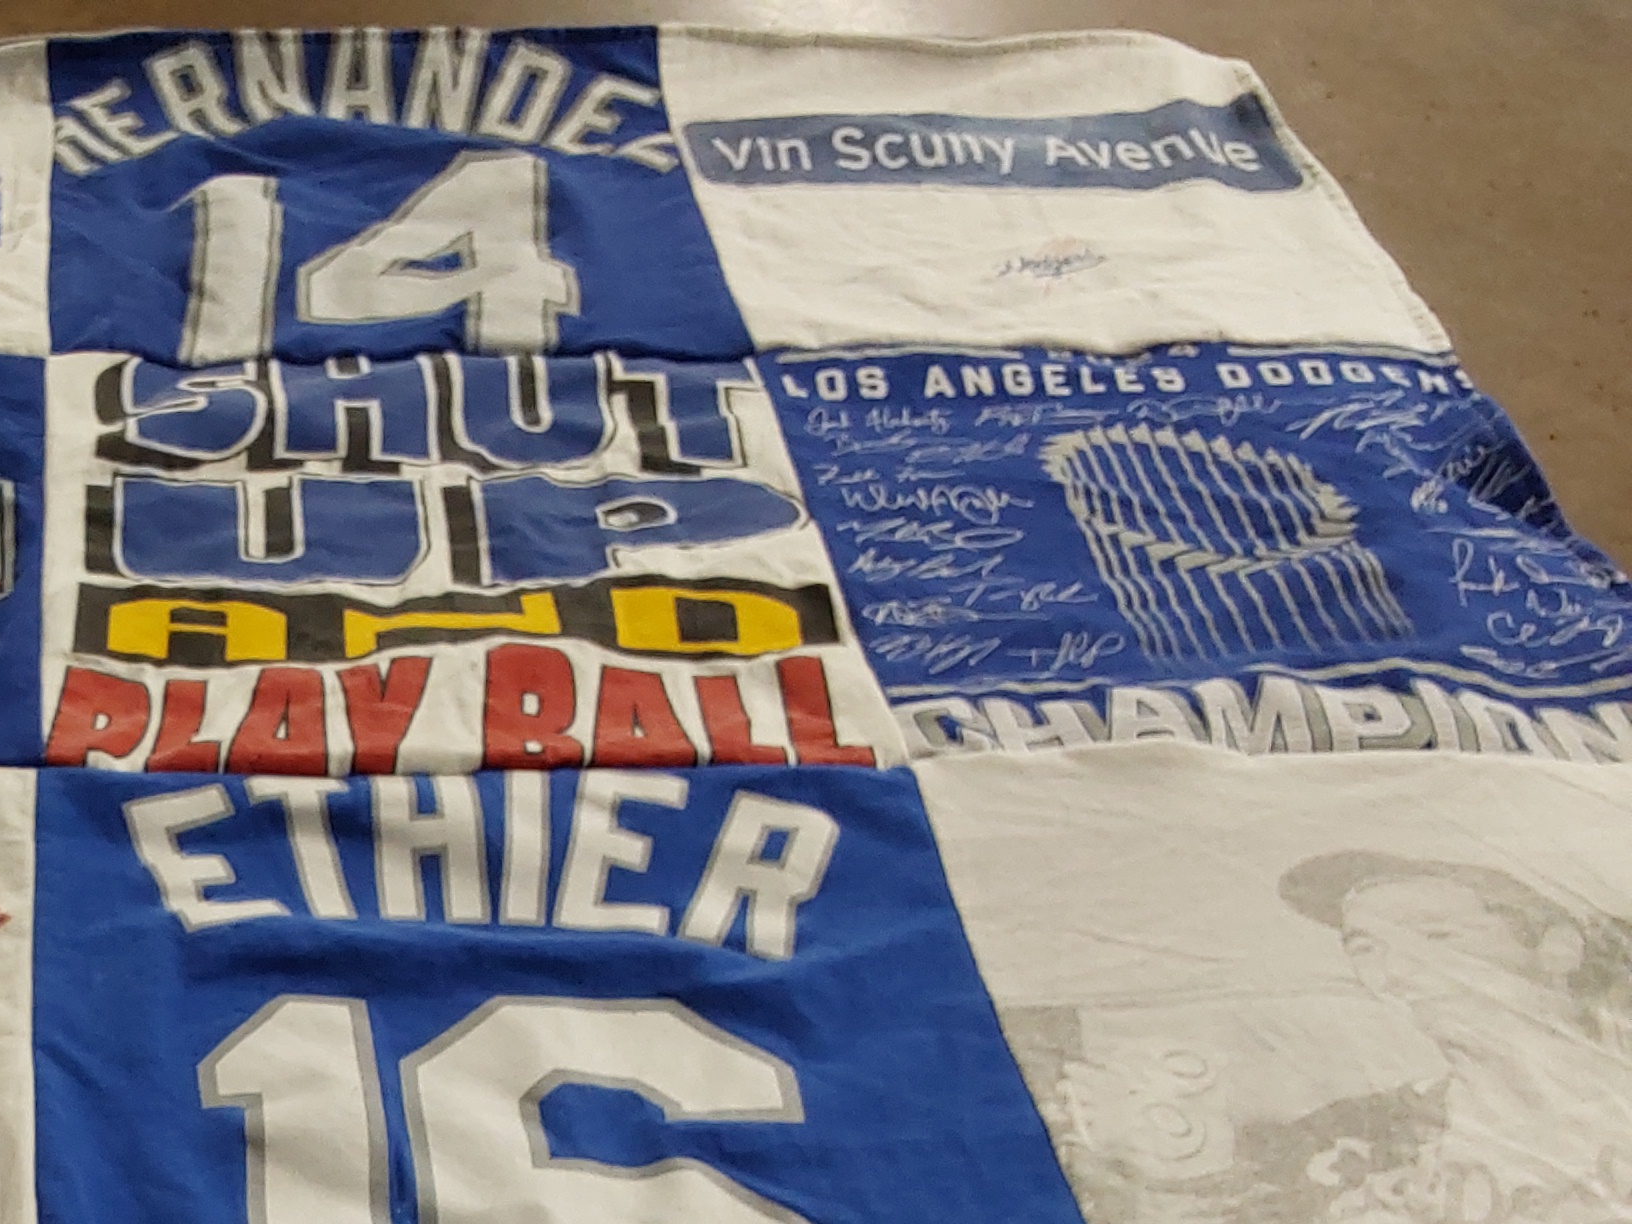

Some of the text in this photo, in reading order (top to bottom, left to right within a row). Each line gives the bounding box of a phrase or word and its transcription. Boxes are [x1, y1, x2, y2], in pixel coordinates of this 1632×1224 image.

[168, 149, 581, 366] 14
[94, 352, 762, 476] SHUT
[781, 364, 890, 402] LOS
[923, 360, 1187, 399] ANGELES
[84, 470, 812, 588] UP
[45, 655, 434, 776] PLAY
[483, 643, 879, 769] BALL
[123, 772, 840, 962] ETHIER
